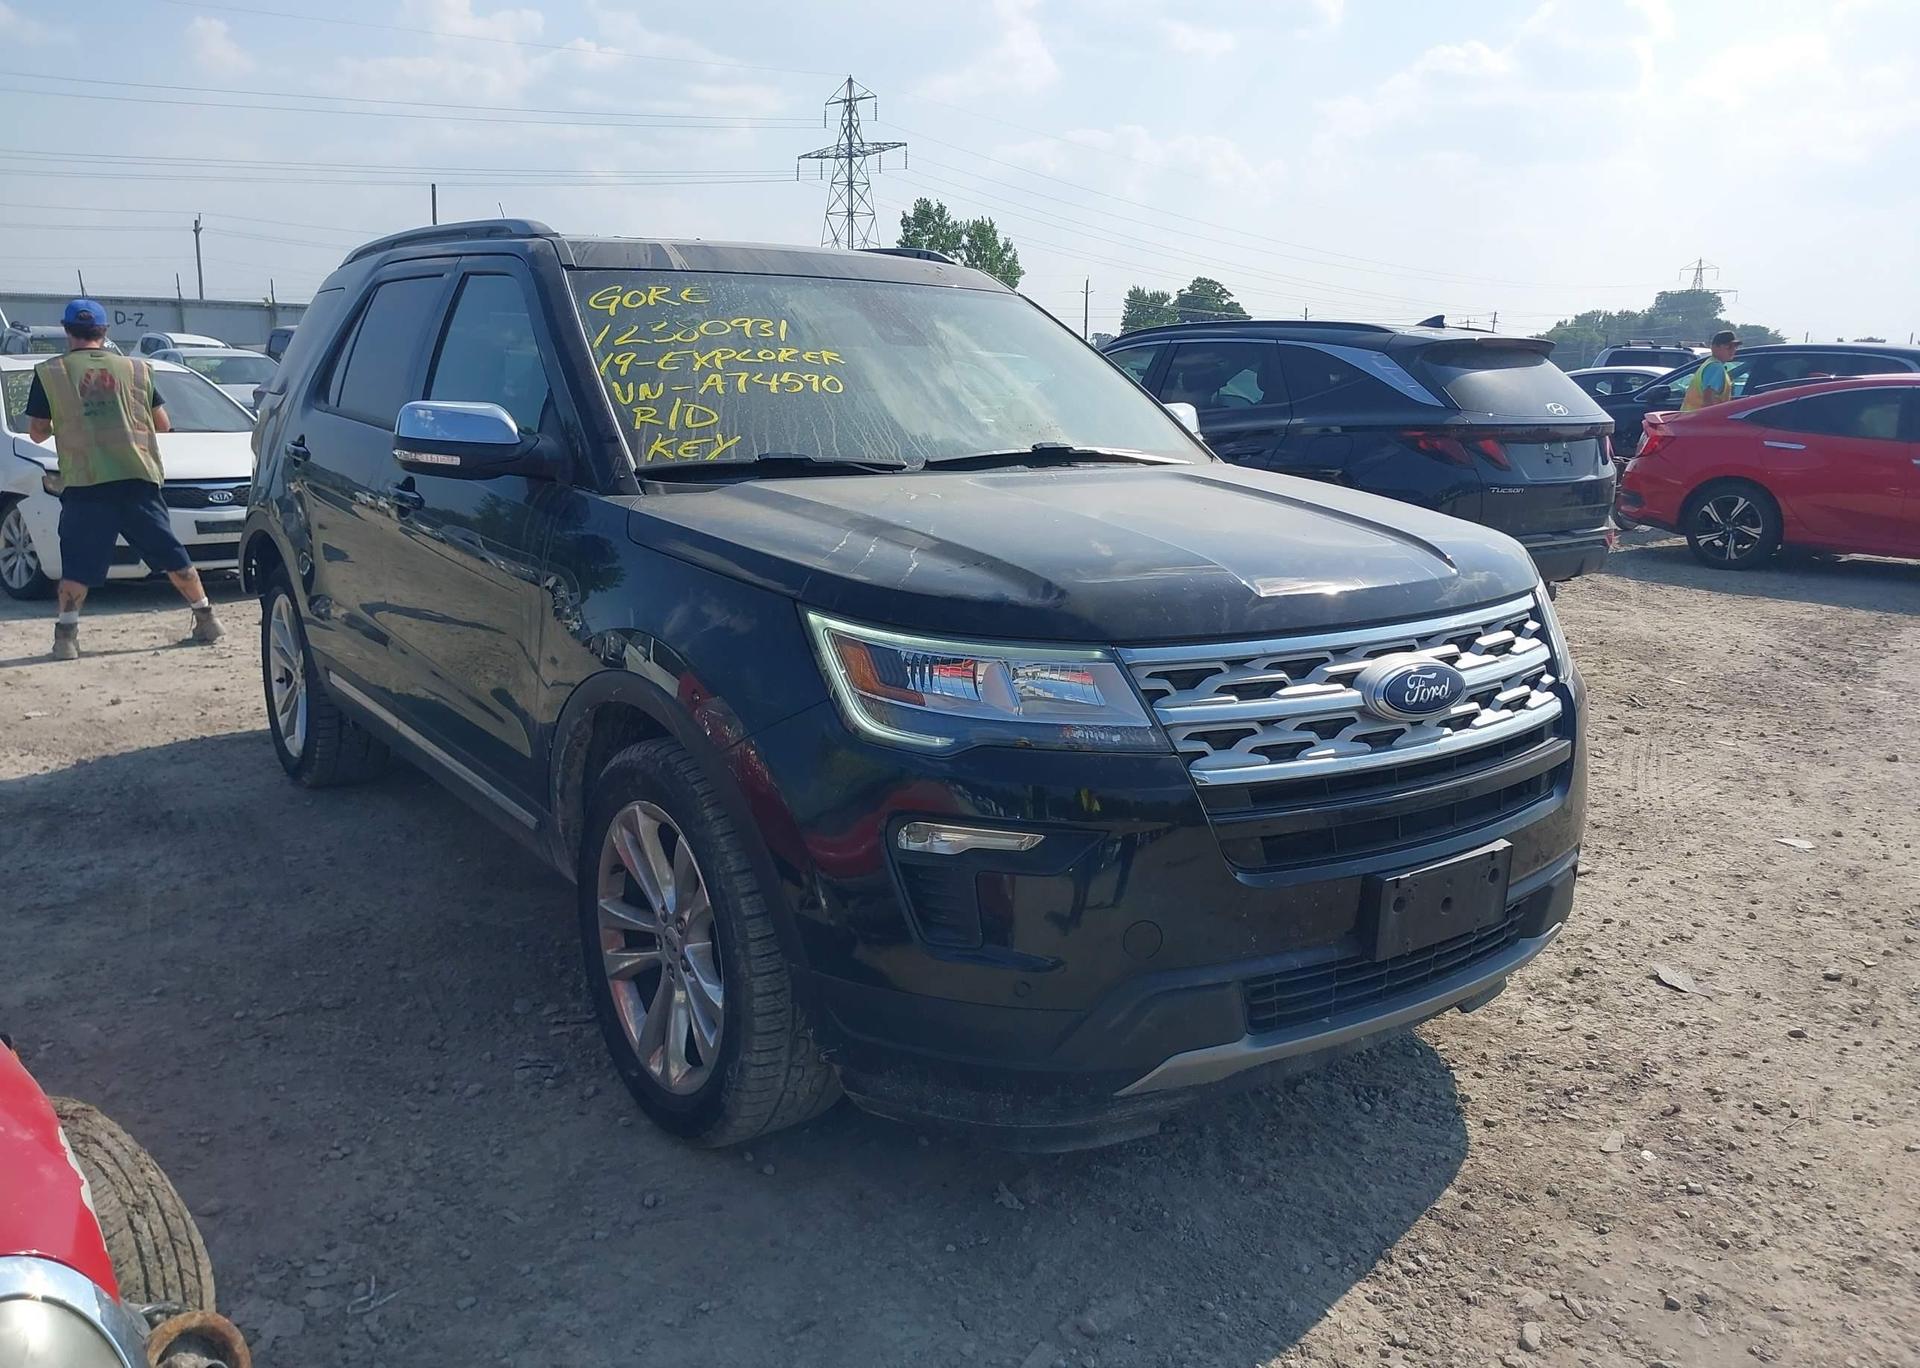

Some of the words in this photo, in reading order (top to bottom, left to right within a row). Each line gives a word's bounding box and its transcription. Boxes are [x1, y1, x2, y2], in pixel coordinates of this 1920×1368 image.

[588, 285, 710, 316] GORE
[599, 347, 846, 377] 19-EXPLORER
[646, 432, 742, 462] KEY
[1404, 672, 1452, 706] Ford
